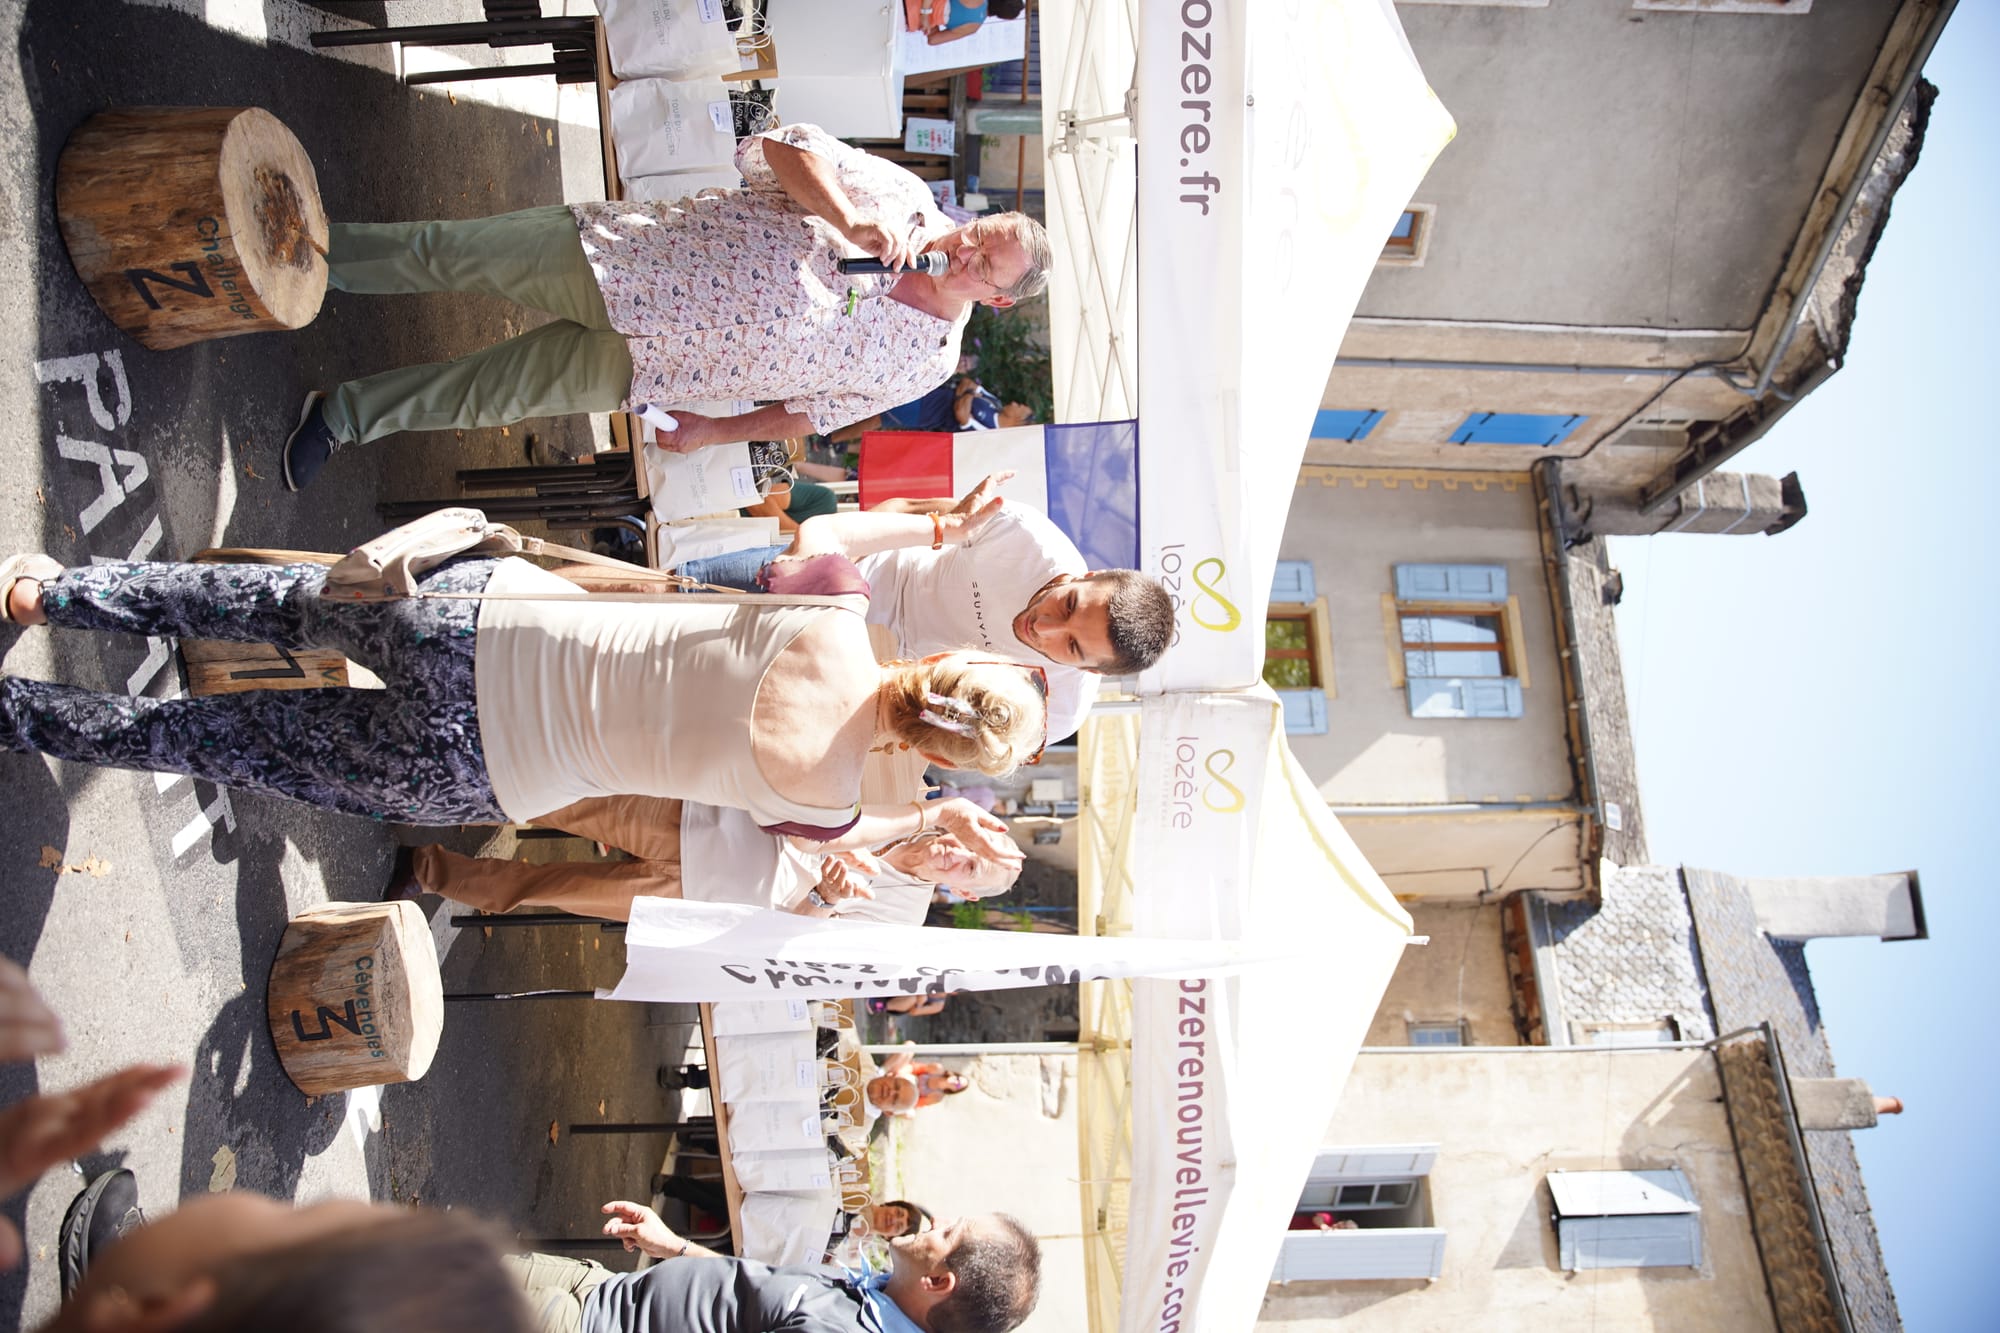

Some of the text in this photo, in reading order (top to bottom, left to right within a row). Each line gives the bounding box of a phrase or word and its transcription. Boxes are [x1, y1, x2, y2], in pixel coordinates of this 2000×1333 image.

[196, 217, 258, 320] Challenge
[1172, 736, 1200, 829] lozère
[291, 999, 362, 1042] 3
[355, 956, 385, 1058] Cévenoles
